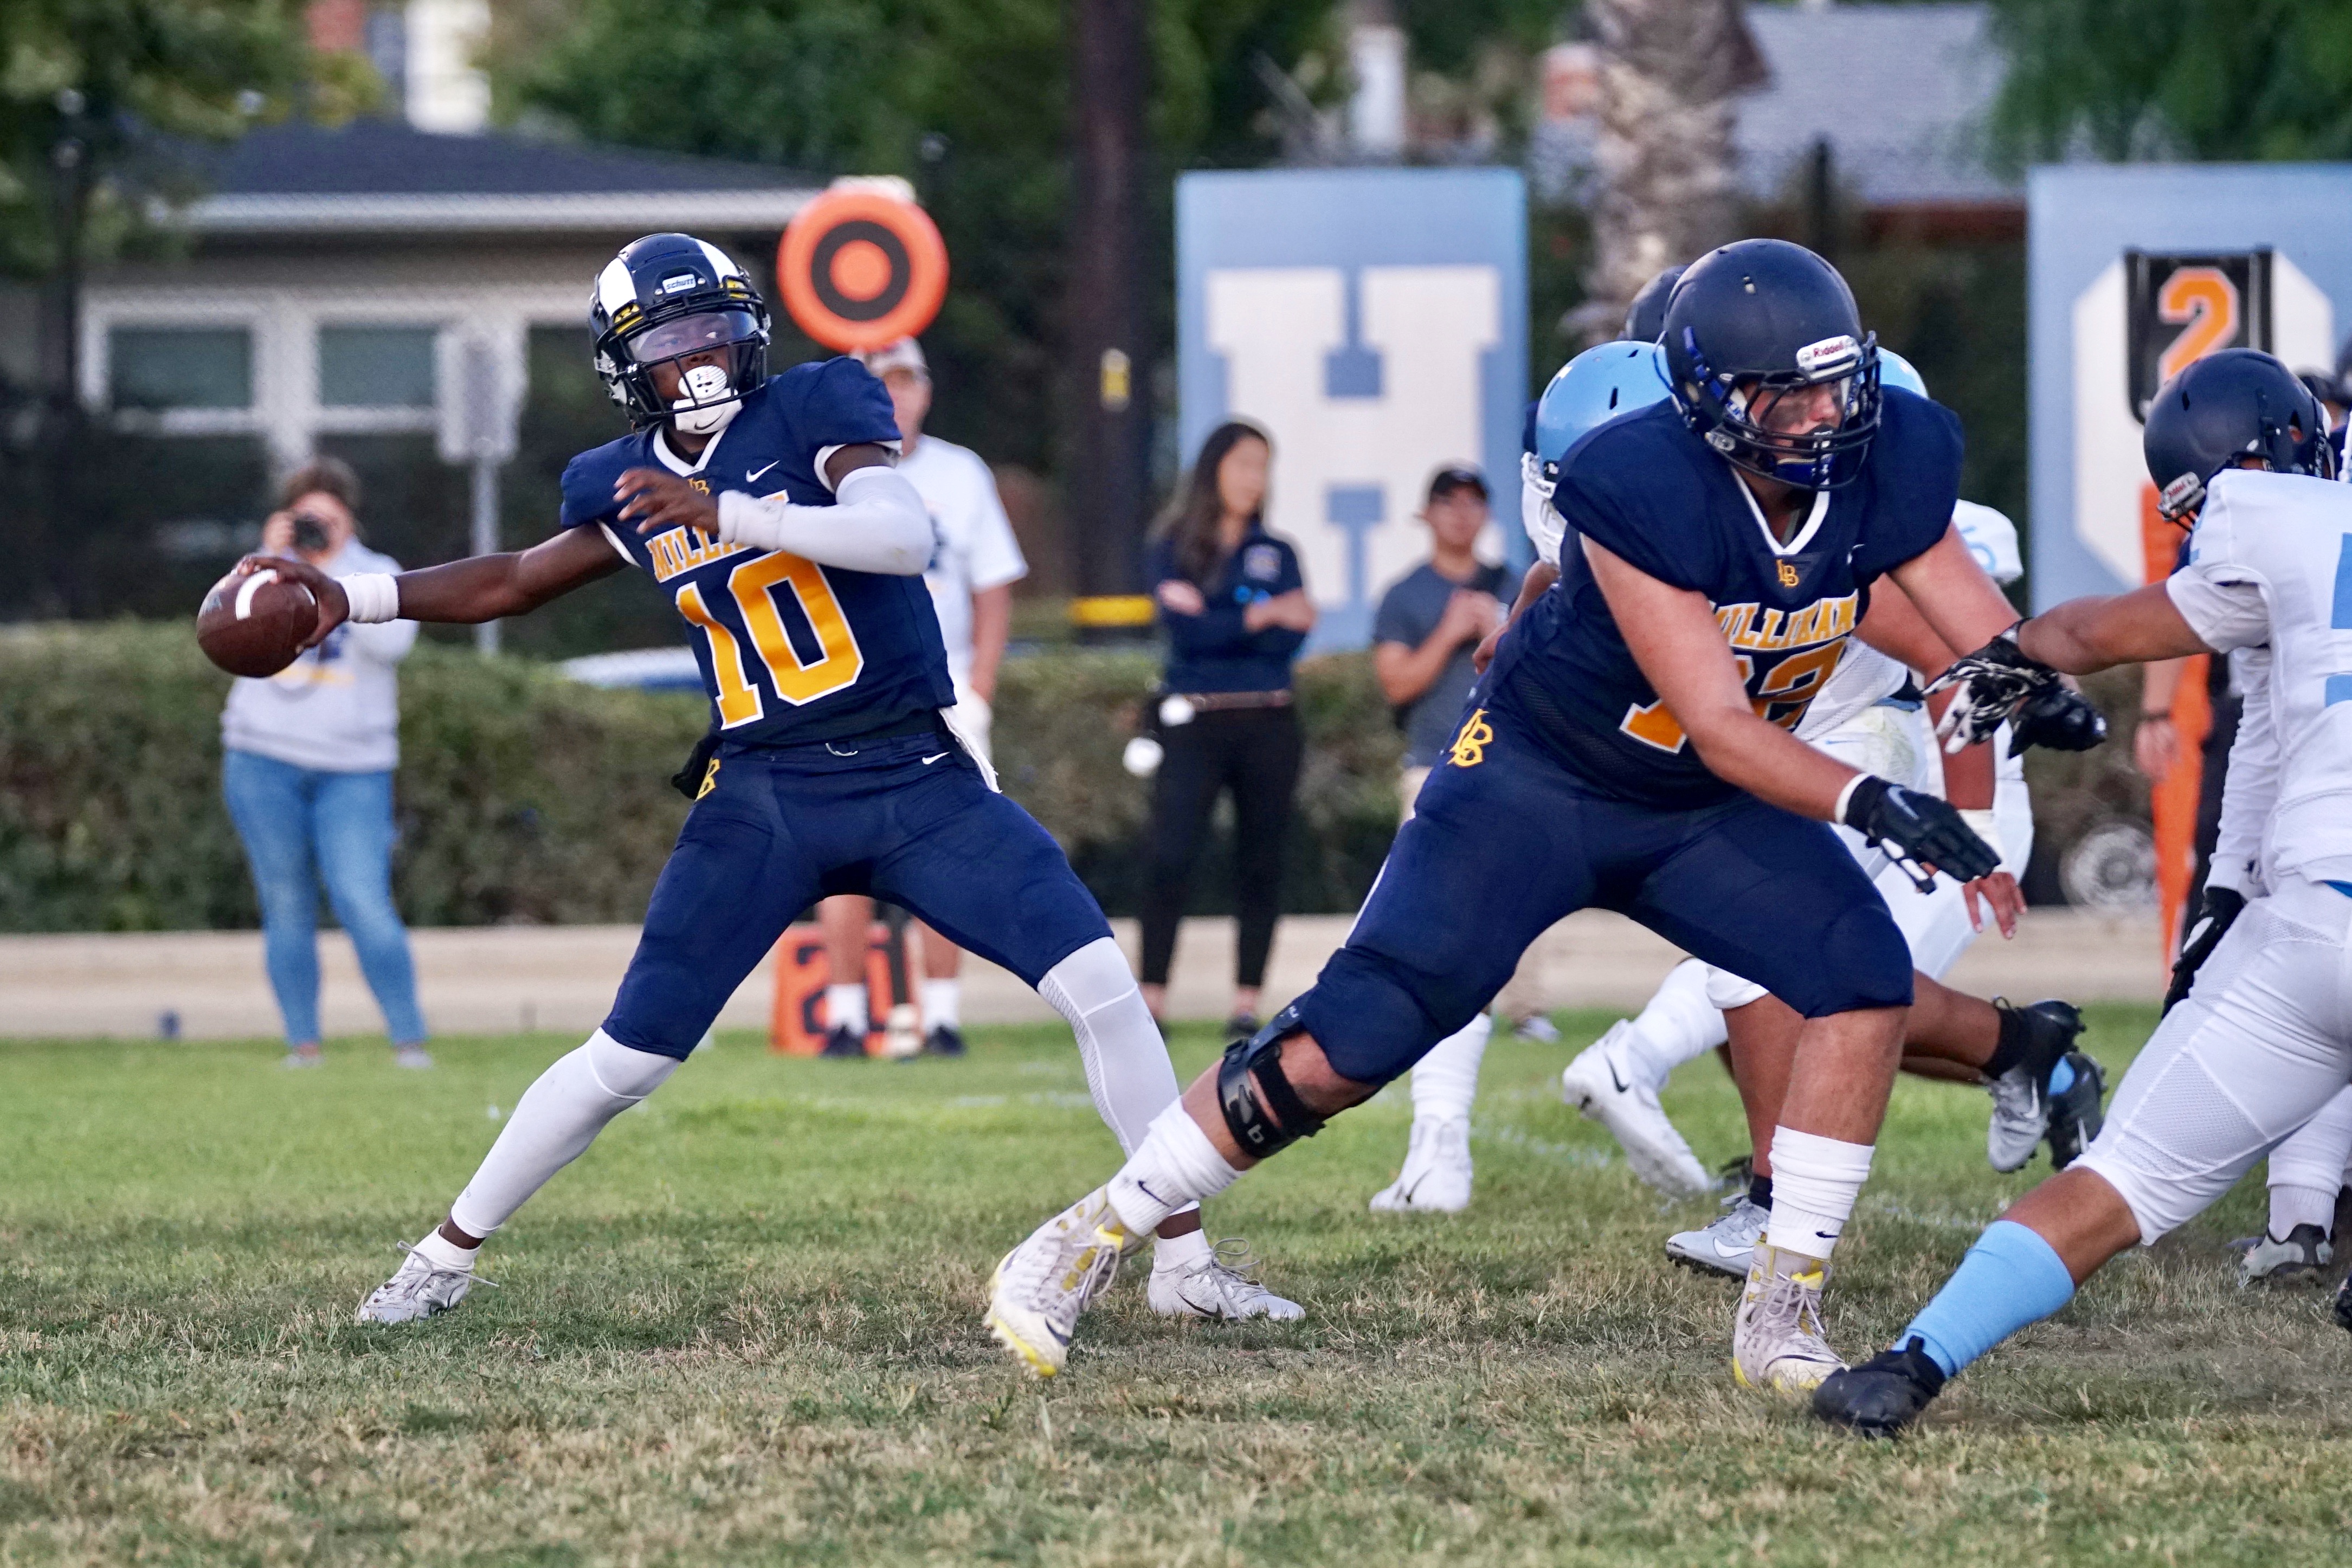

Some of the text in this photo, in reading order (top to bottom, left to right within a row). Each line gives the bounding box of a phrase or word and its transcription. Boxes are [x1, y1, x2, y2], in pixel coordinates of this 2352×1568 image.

[2158, 266, 2237, 390] 2
[1205, 264, 1503, 607] H
[675, 549, 865, 730] 10
